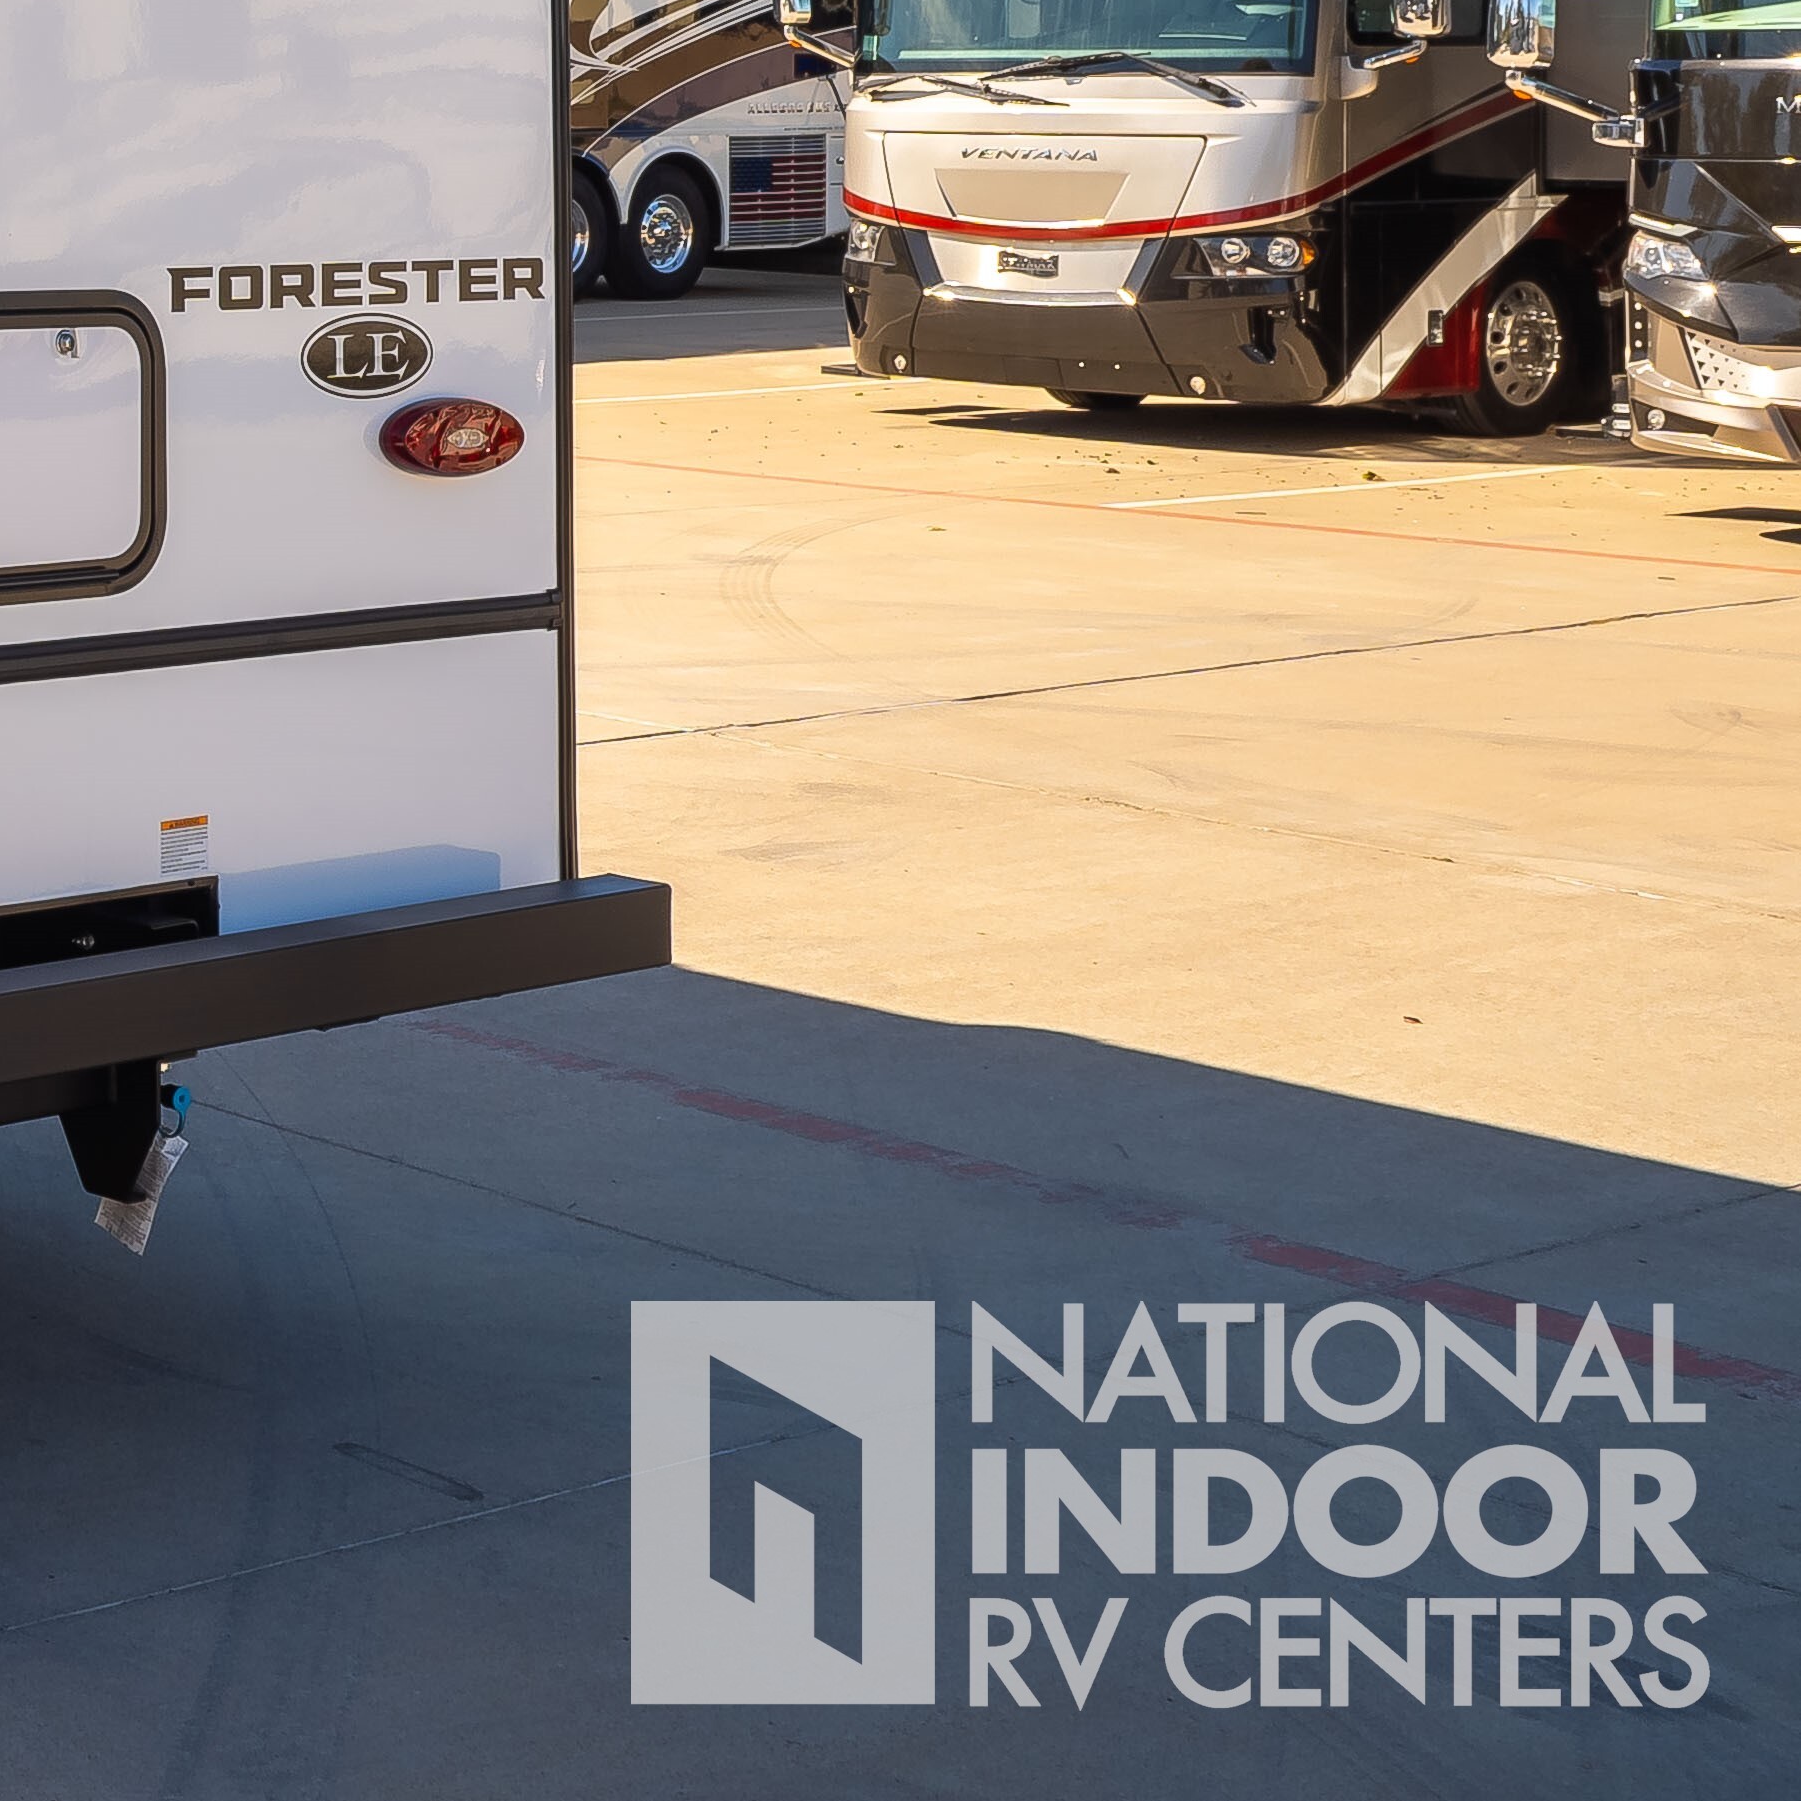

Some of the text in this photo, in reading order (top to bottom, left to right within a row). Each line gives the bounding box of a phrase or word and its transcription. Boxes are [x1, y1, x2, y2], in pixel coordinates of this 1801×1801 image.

[961, 147, 1098, 162] VENTANA
[166, 257, 547, 313] FORESTER
[327, 329, 409, 380] LE
